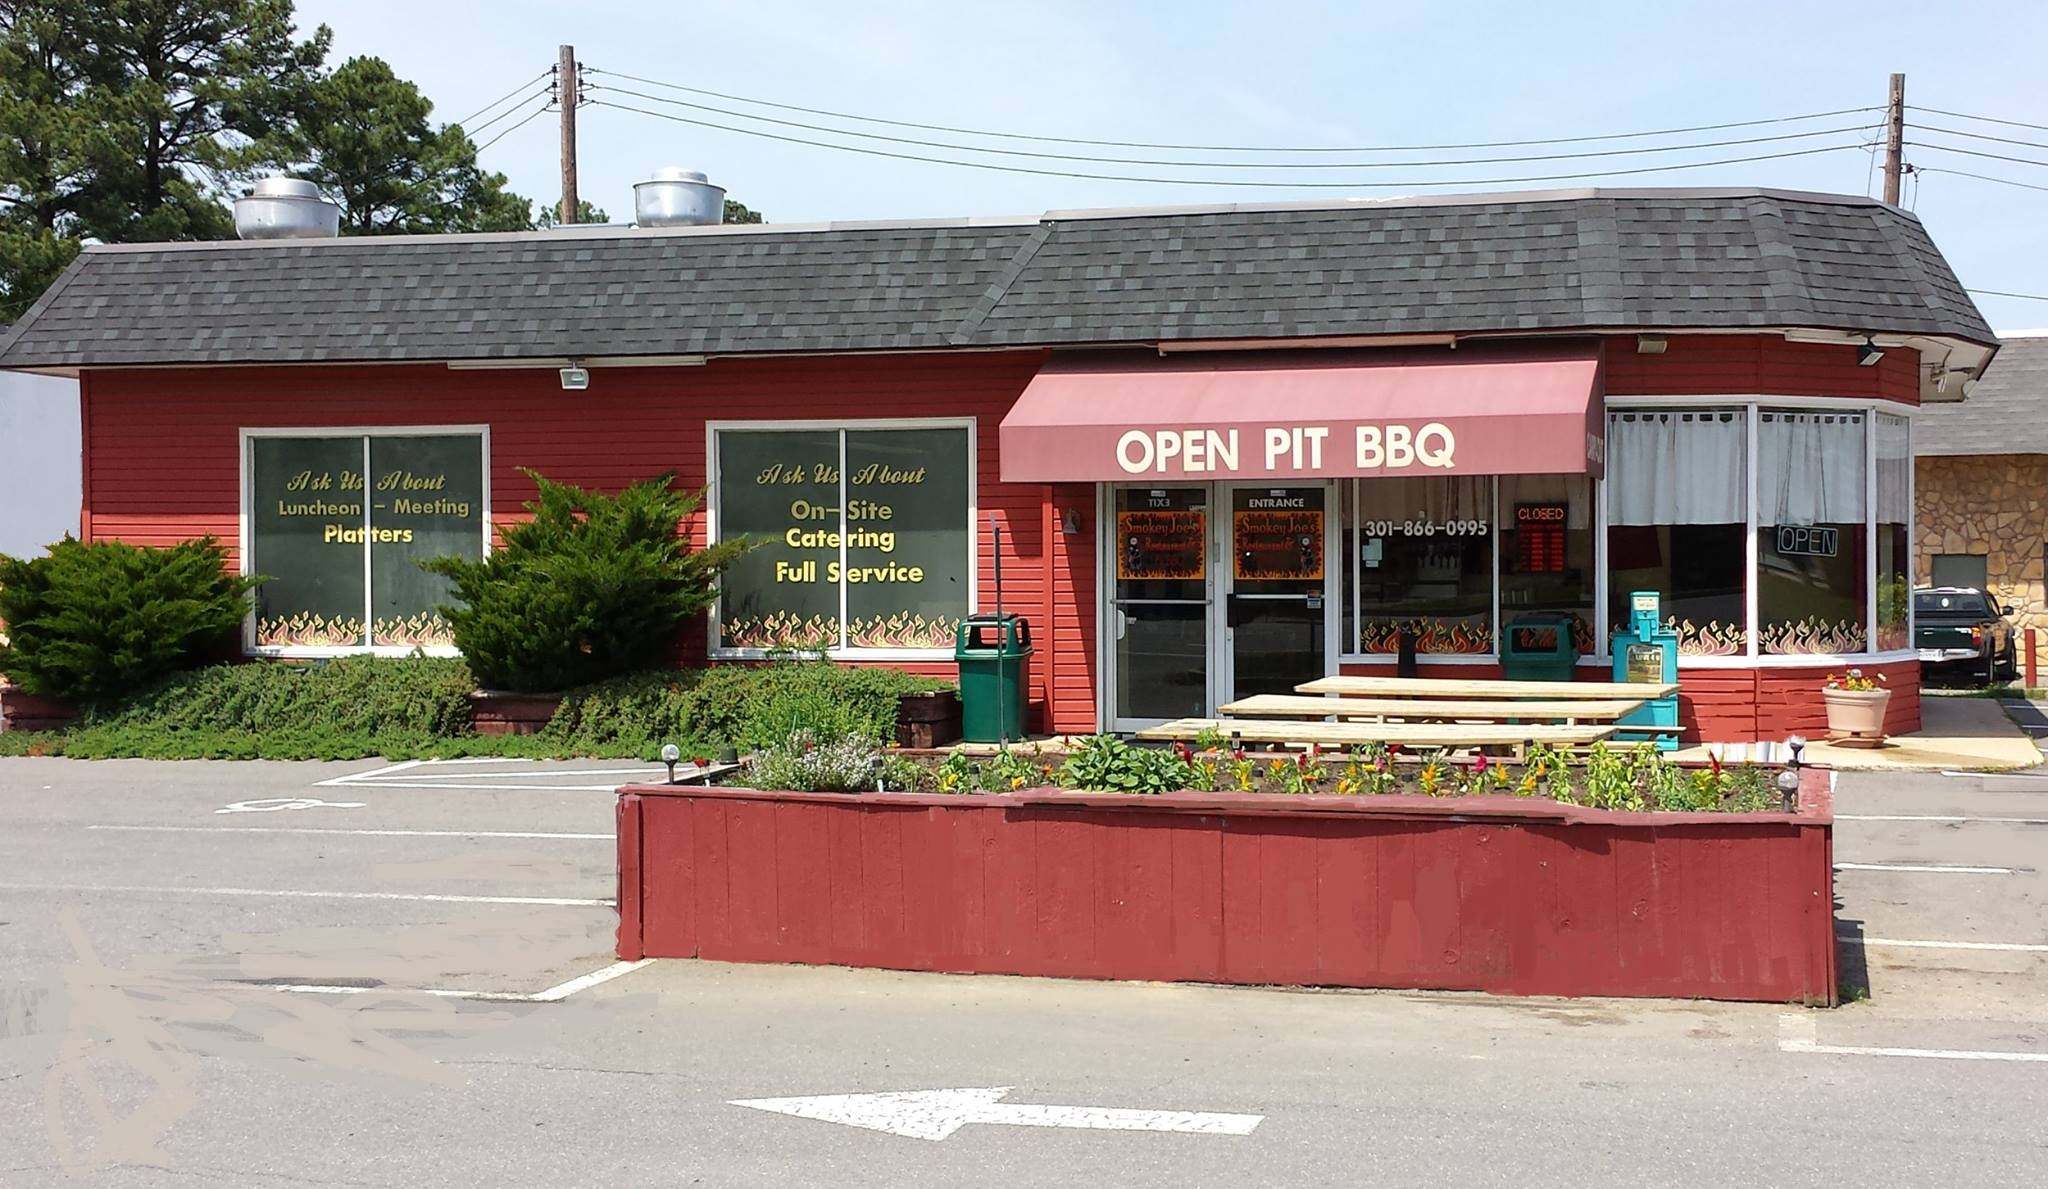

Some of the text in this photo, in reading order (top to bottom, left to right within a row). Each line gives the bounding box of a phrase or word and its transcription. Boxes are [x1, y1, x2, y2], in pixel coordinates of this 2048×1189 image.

[1116, 422, 1455, 474] OPEN PIT BBQ
[287, 470, 446, 491] Ask Us About
[757, 463, 926, 485] Ask Us About
[278, 500, 361, 515] Luncheon
[394, 499, 469, 517] Meeting
[1248, 498, 1304, 508] ENTRANCE
[1518, 508, 1564, 520] CLOSED
[324, 524, 413, 543] Platters
[1365, 520, 1488, 537] 301-866-0995
[785, 527, 895, 552] Catering
[1781, 527, 1835, 554] OPEN
[776, 560, 924, 583] Full Service
